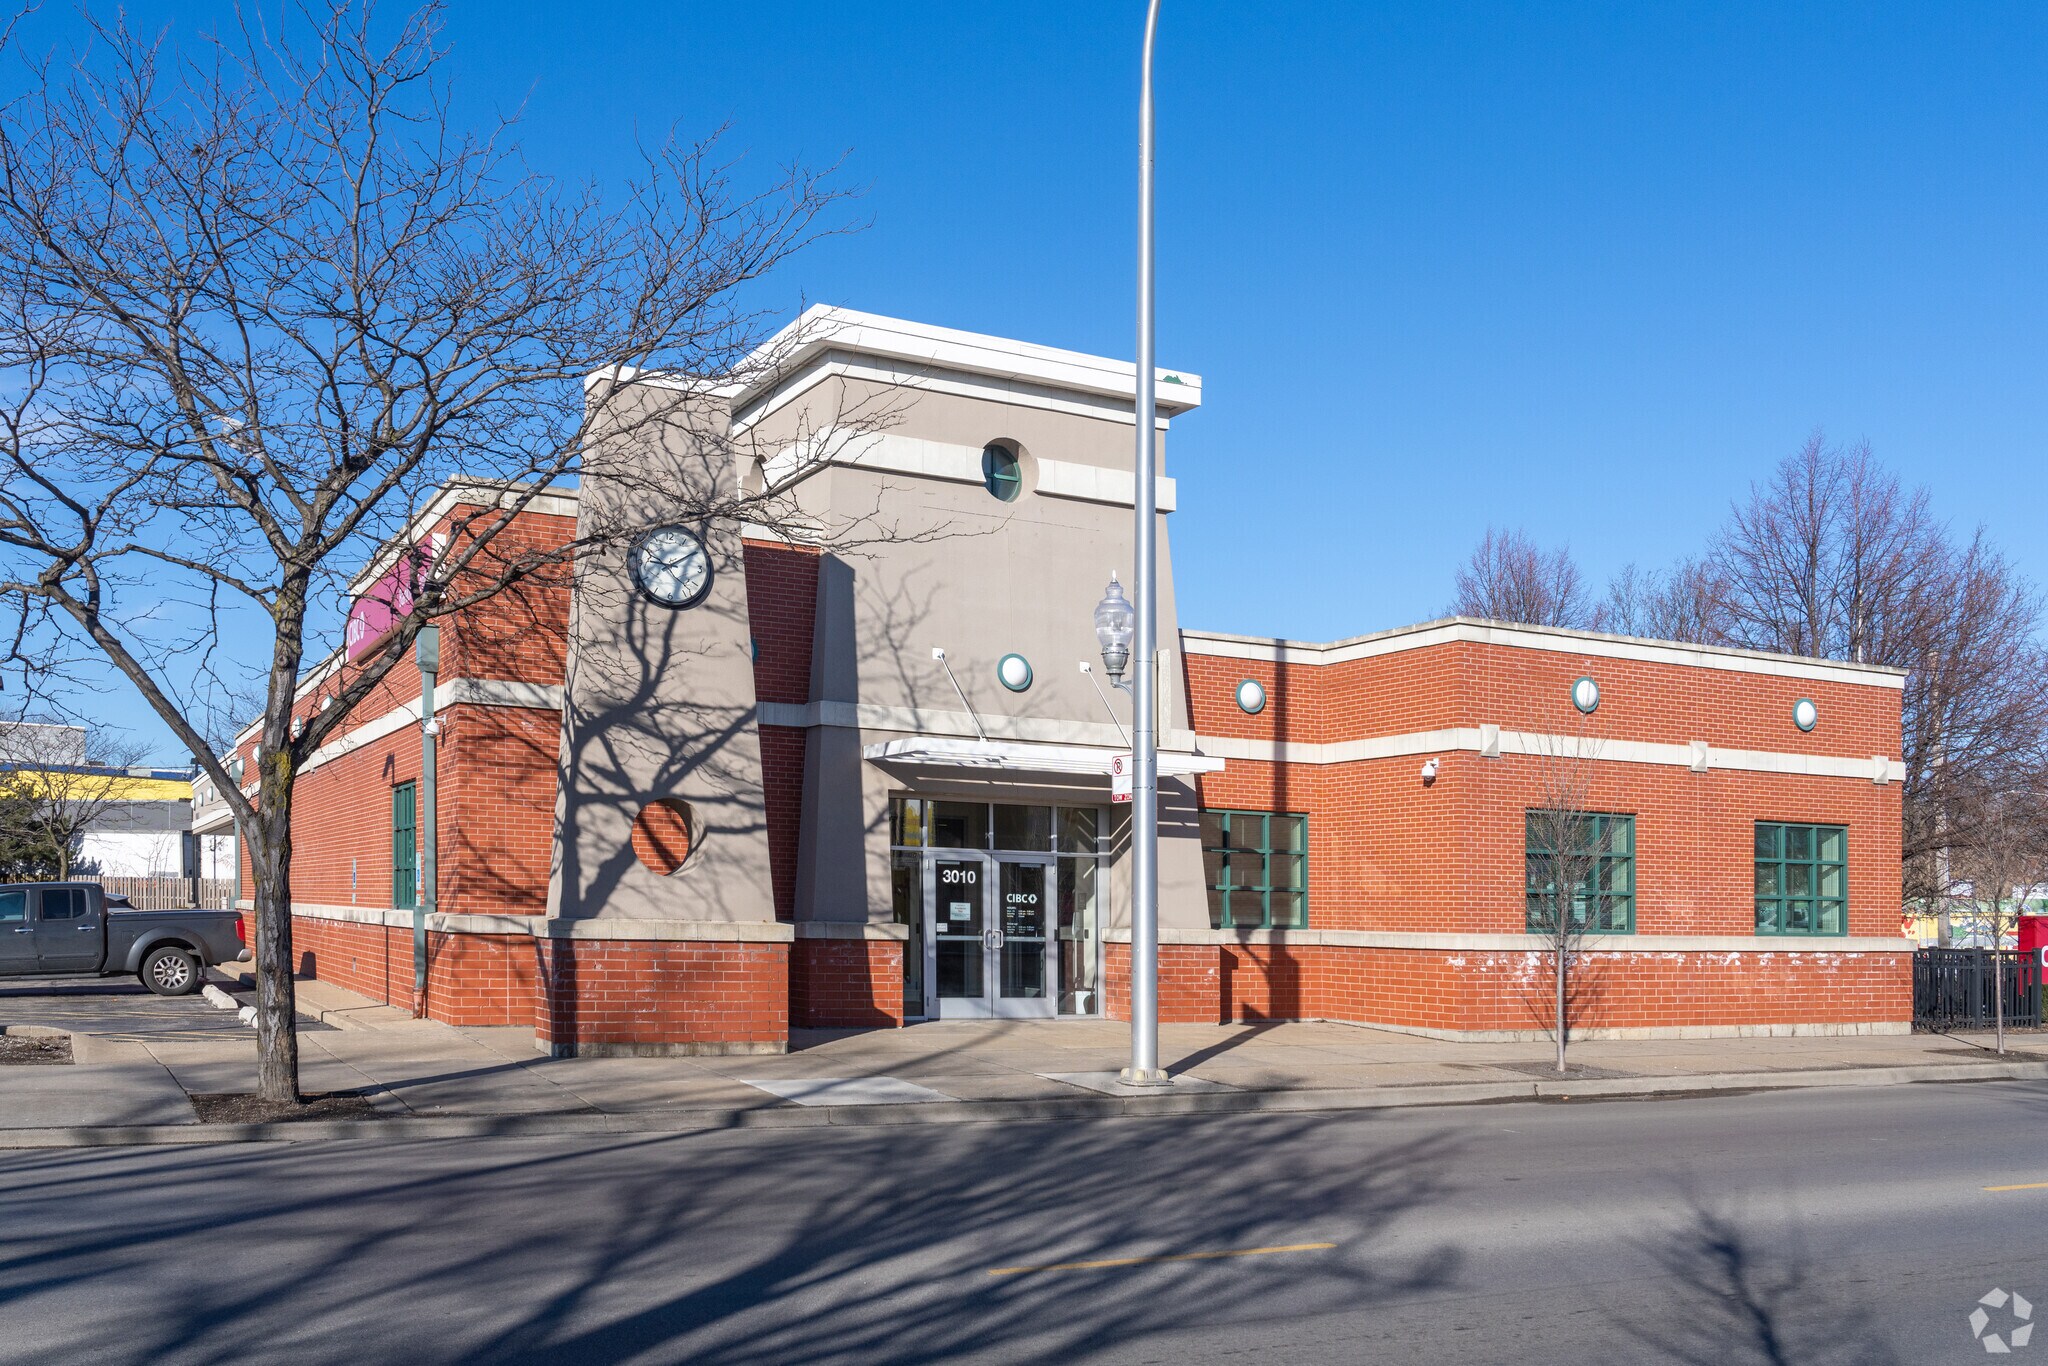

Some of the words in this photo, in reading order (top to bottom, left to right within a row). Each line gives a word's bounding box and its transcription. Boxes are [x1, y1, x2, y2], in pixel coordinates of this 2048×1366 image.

[666, 532, 674, 541] 12
[697, 565, 703, 574] 3
[667, 592, 674, 600] 6
[942, 869, 976, 884] 3010
[1006, 893, 1028, 903] CIBC
